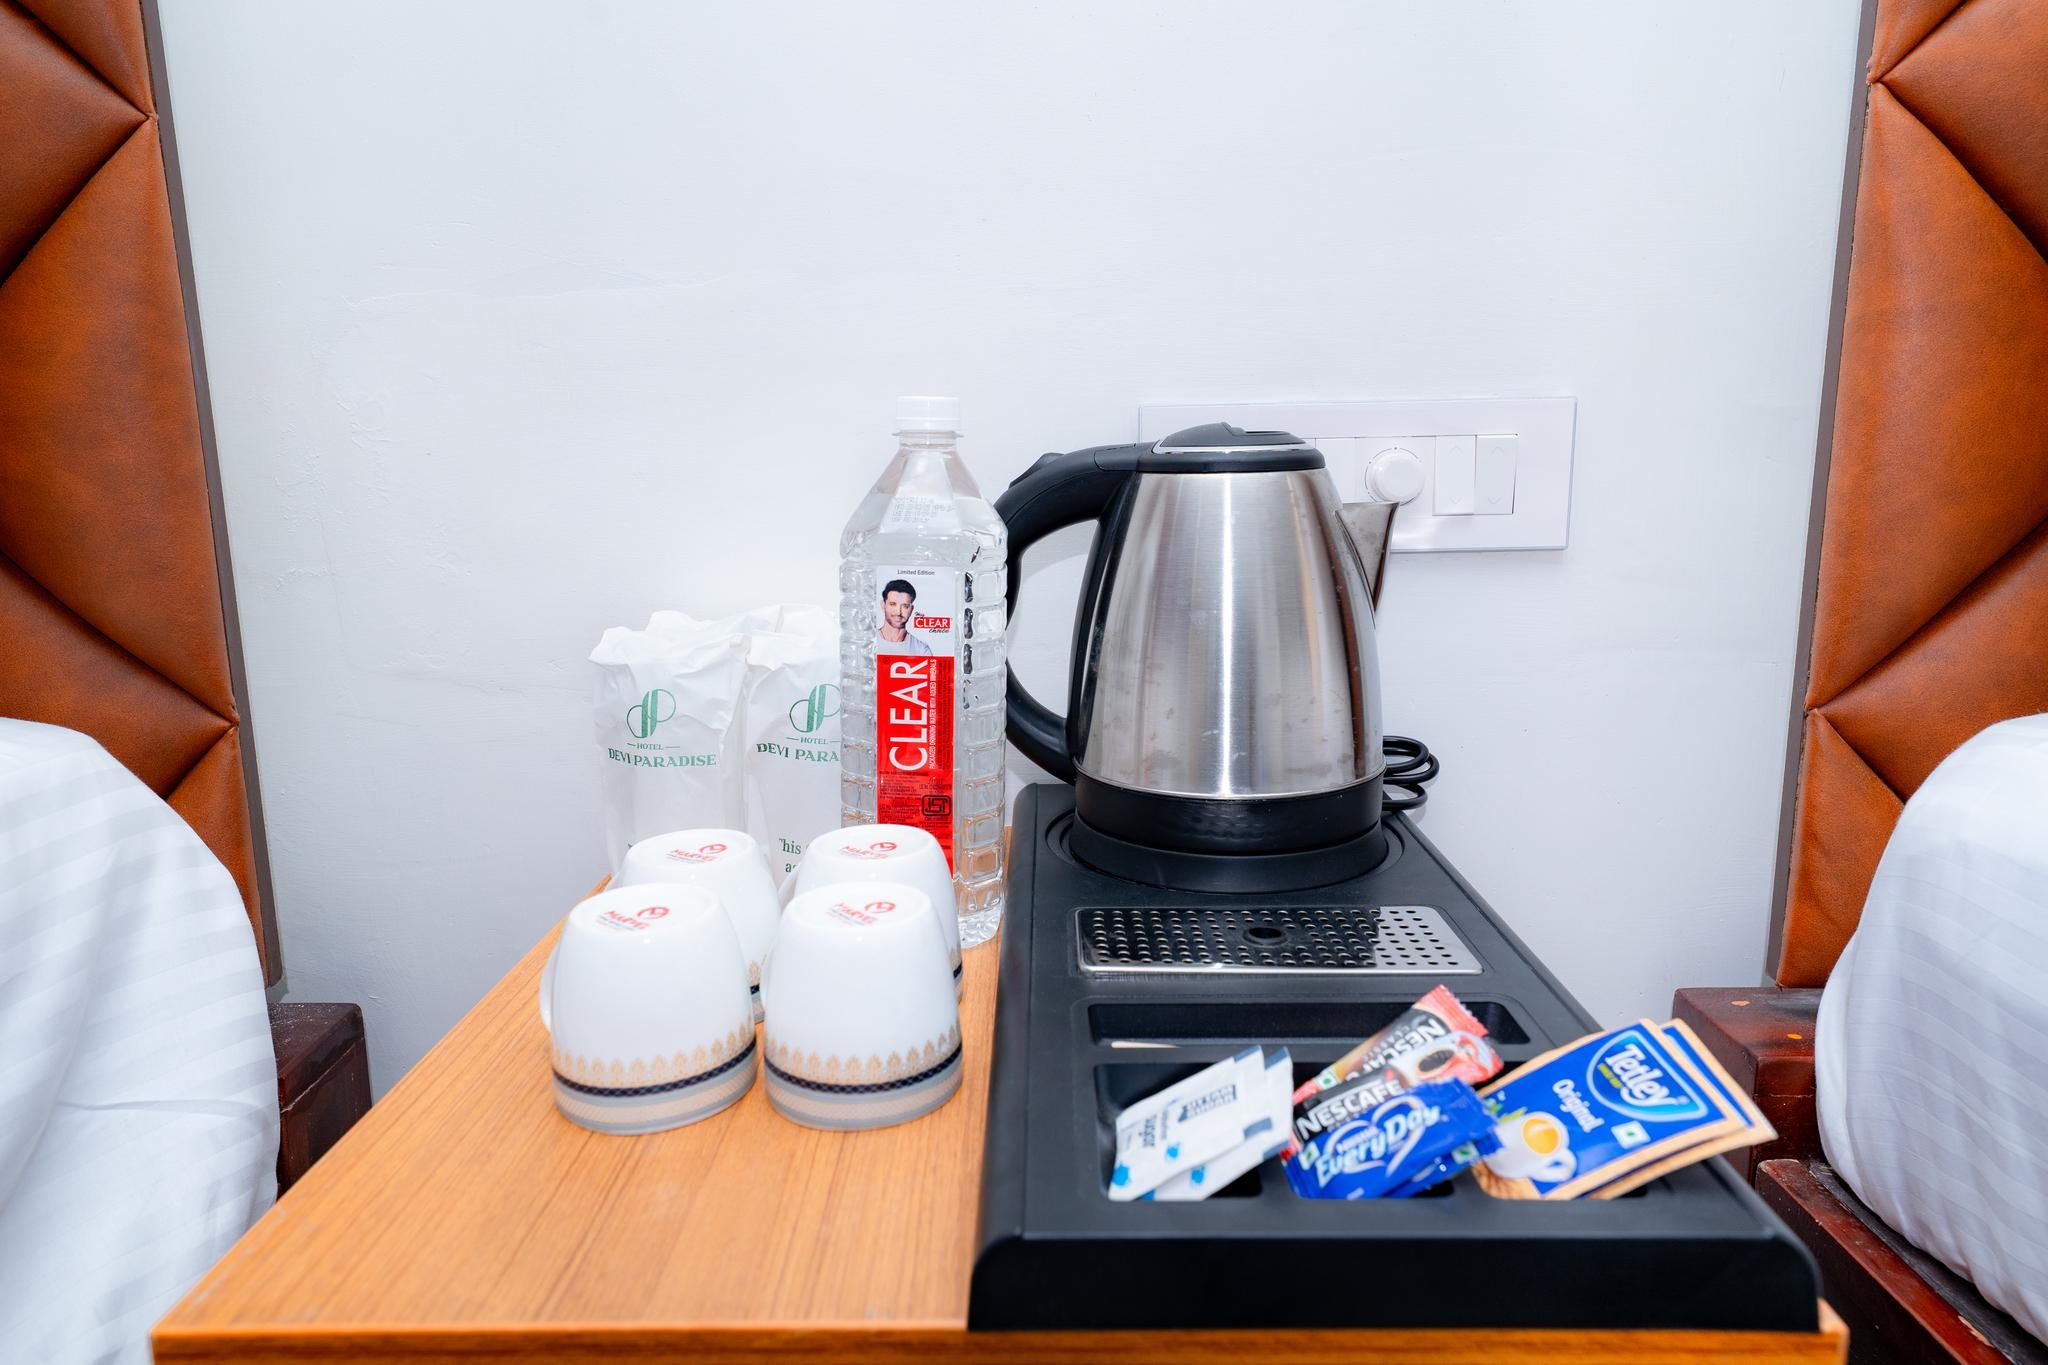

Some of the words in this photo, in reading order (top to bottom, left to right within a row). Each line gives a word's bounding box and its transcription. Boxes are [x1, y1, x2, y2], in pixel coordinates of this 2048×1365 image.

[915, 618, 949, 628] CLEAR
[888, 659, 929, 771] CLEAR
[636, 742, 664, 750] HOTEL
[799, 736, 829, 745] HOTEL
[608, 748, 631, 764] DEVI
[633, 754, 717, 768] PARADISE
[756, 742, 789, 758] DEVI
[795, 748, 840, 762] PARA
[1605, 1044, 1690, 1106] Tetley
[1552, 1078, 1605, 1133] Original
